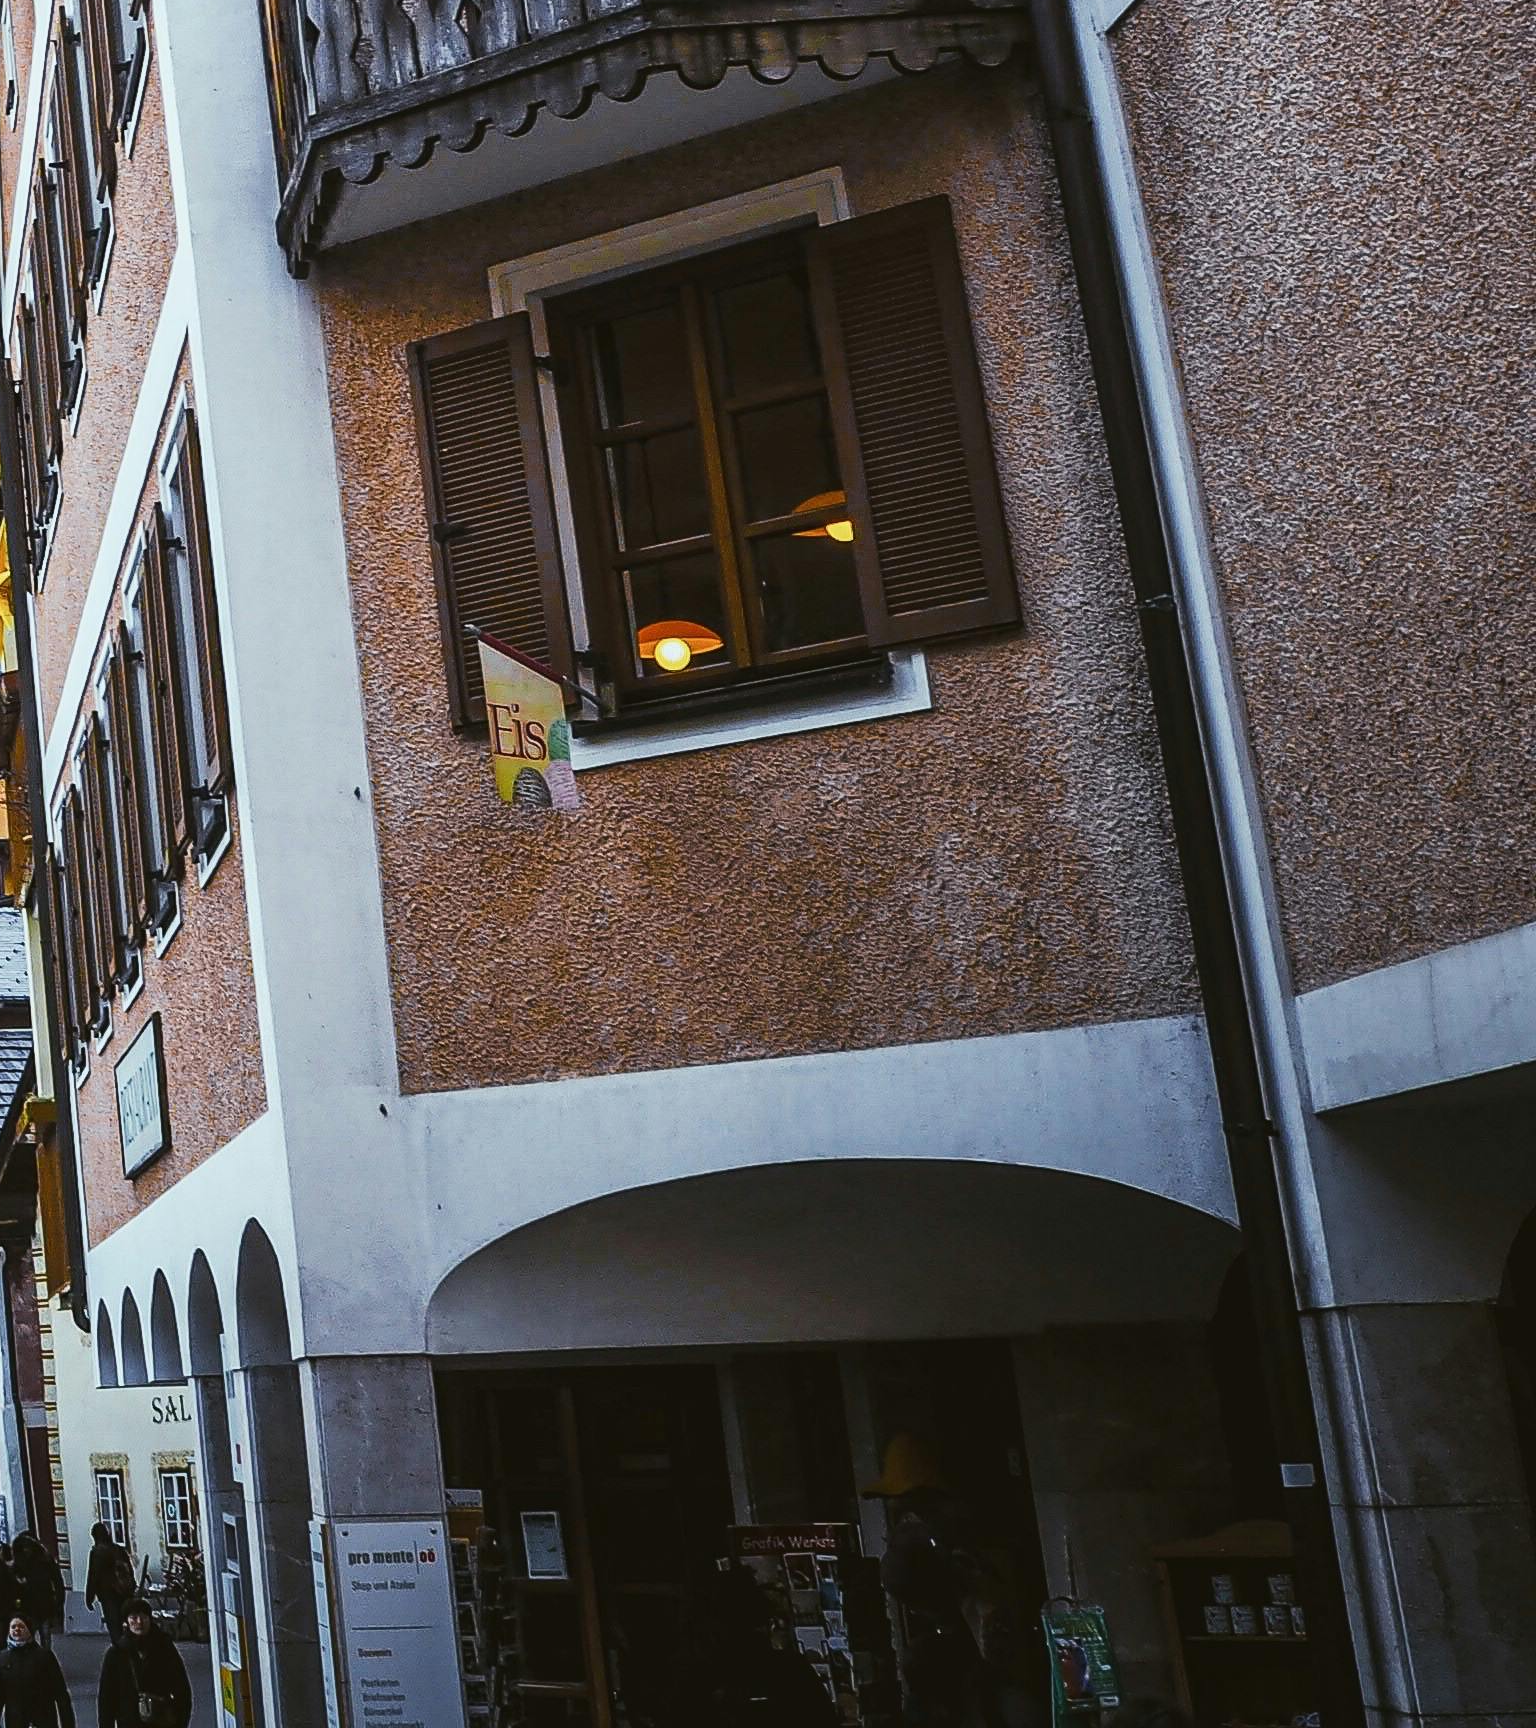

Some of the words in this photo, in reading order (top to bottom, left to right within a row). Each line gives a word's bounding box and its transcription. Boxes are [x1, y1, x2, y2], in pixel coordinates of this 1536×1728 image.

[488, 703, 547, 760] Eis
[348, 1552, 370, 1566] pro
[372, 1551, 414, 1563] mente
